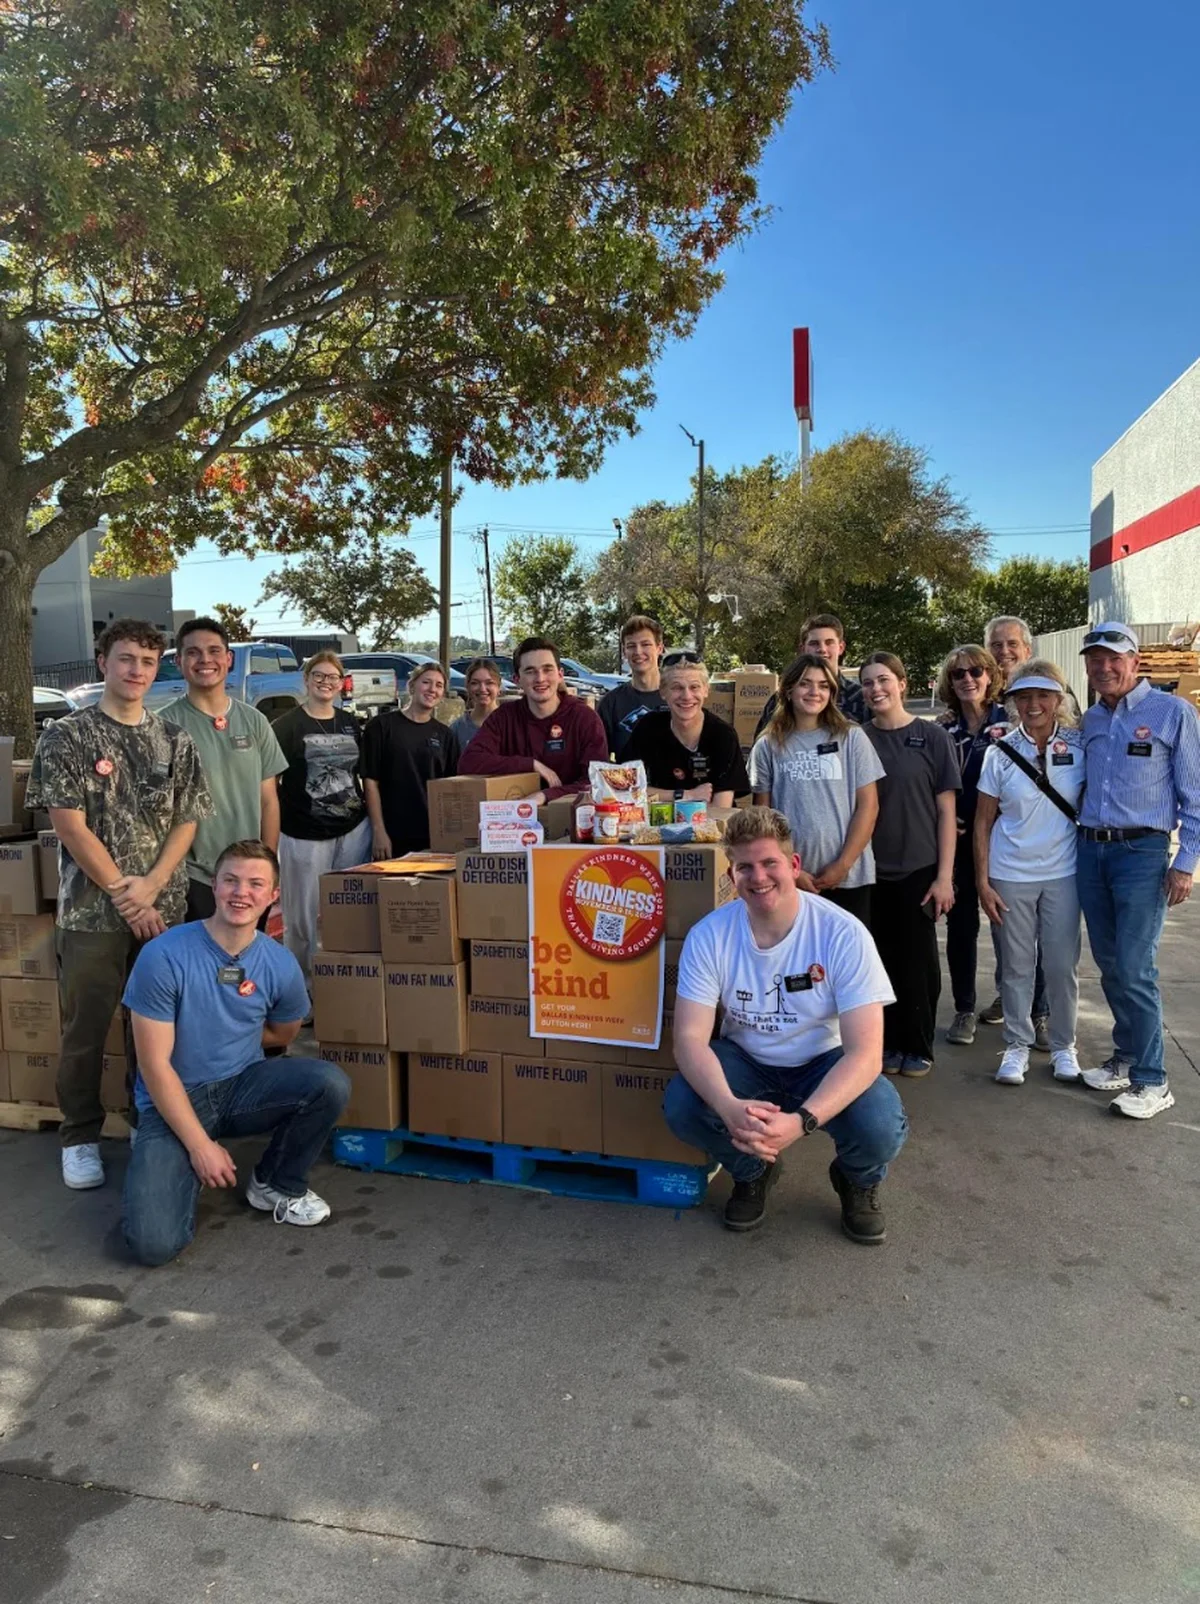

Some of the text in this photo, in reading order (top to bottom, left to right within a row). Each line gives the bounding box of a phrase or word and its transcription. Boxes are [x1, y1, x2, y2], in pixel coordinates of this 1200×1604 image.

[795, 750, 818, 760] THE
[790, 770, 820, 781] FACE
[465, 856, 526, 871] AUTO DISH
[674, 852, 703, 867] DISH
[343, 879, 363, 891] DISH
[462, 871, 528, 884] DETERGENT
[566, 864, 588, 897] DALLAS
[589, 853, 637, 866] KINDNESS
[639, 864, 660, 890] WEEK
[655, 892, 663, 916] 2025
[329, 892, 378, 905] DETERGENT
[575, 879, 656, 914] KINDNESS
[575, 897, 617, 912] NOVEMBER
[627, 926, 658, 953] SQUARE
[473, 944, 516, 959] SPAGHETTI
[531, 936, 572, 964] be
[314, 964, 379, 978] NON FAT MILK
[388, 973, 454, 987] NON FAT MILK
[531, 968, 610, 1000] kind
[470, 1000, 512, 1015] SPAGHETTI
[541, 1011, 567, 1019] DALLAS
[569, 1013, 604, 1022] KINDNESS
[541, 1019, 570, 1027] BUTTON
[27, 1055, 49, 1067] RICE
[322, 1050, 385, 1065] NON FAT MILK
[420, 1055, 488, 1074] WHITE FLOUR
[515, 1064, 588, 1083] WHITE FLOUR
[615, 1073, 649, 1090] WHITE
